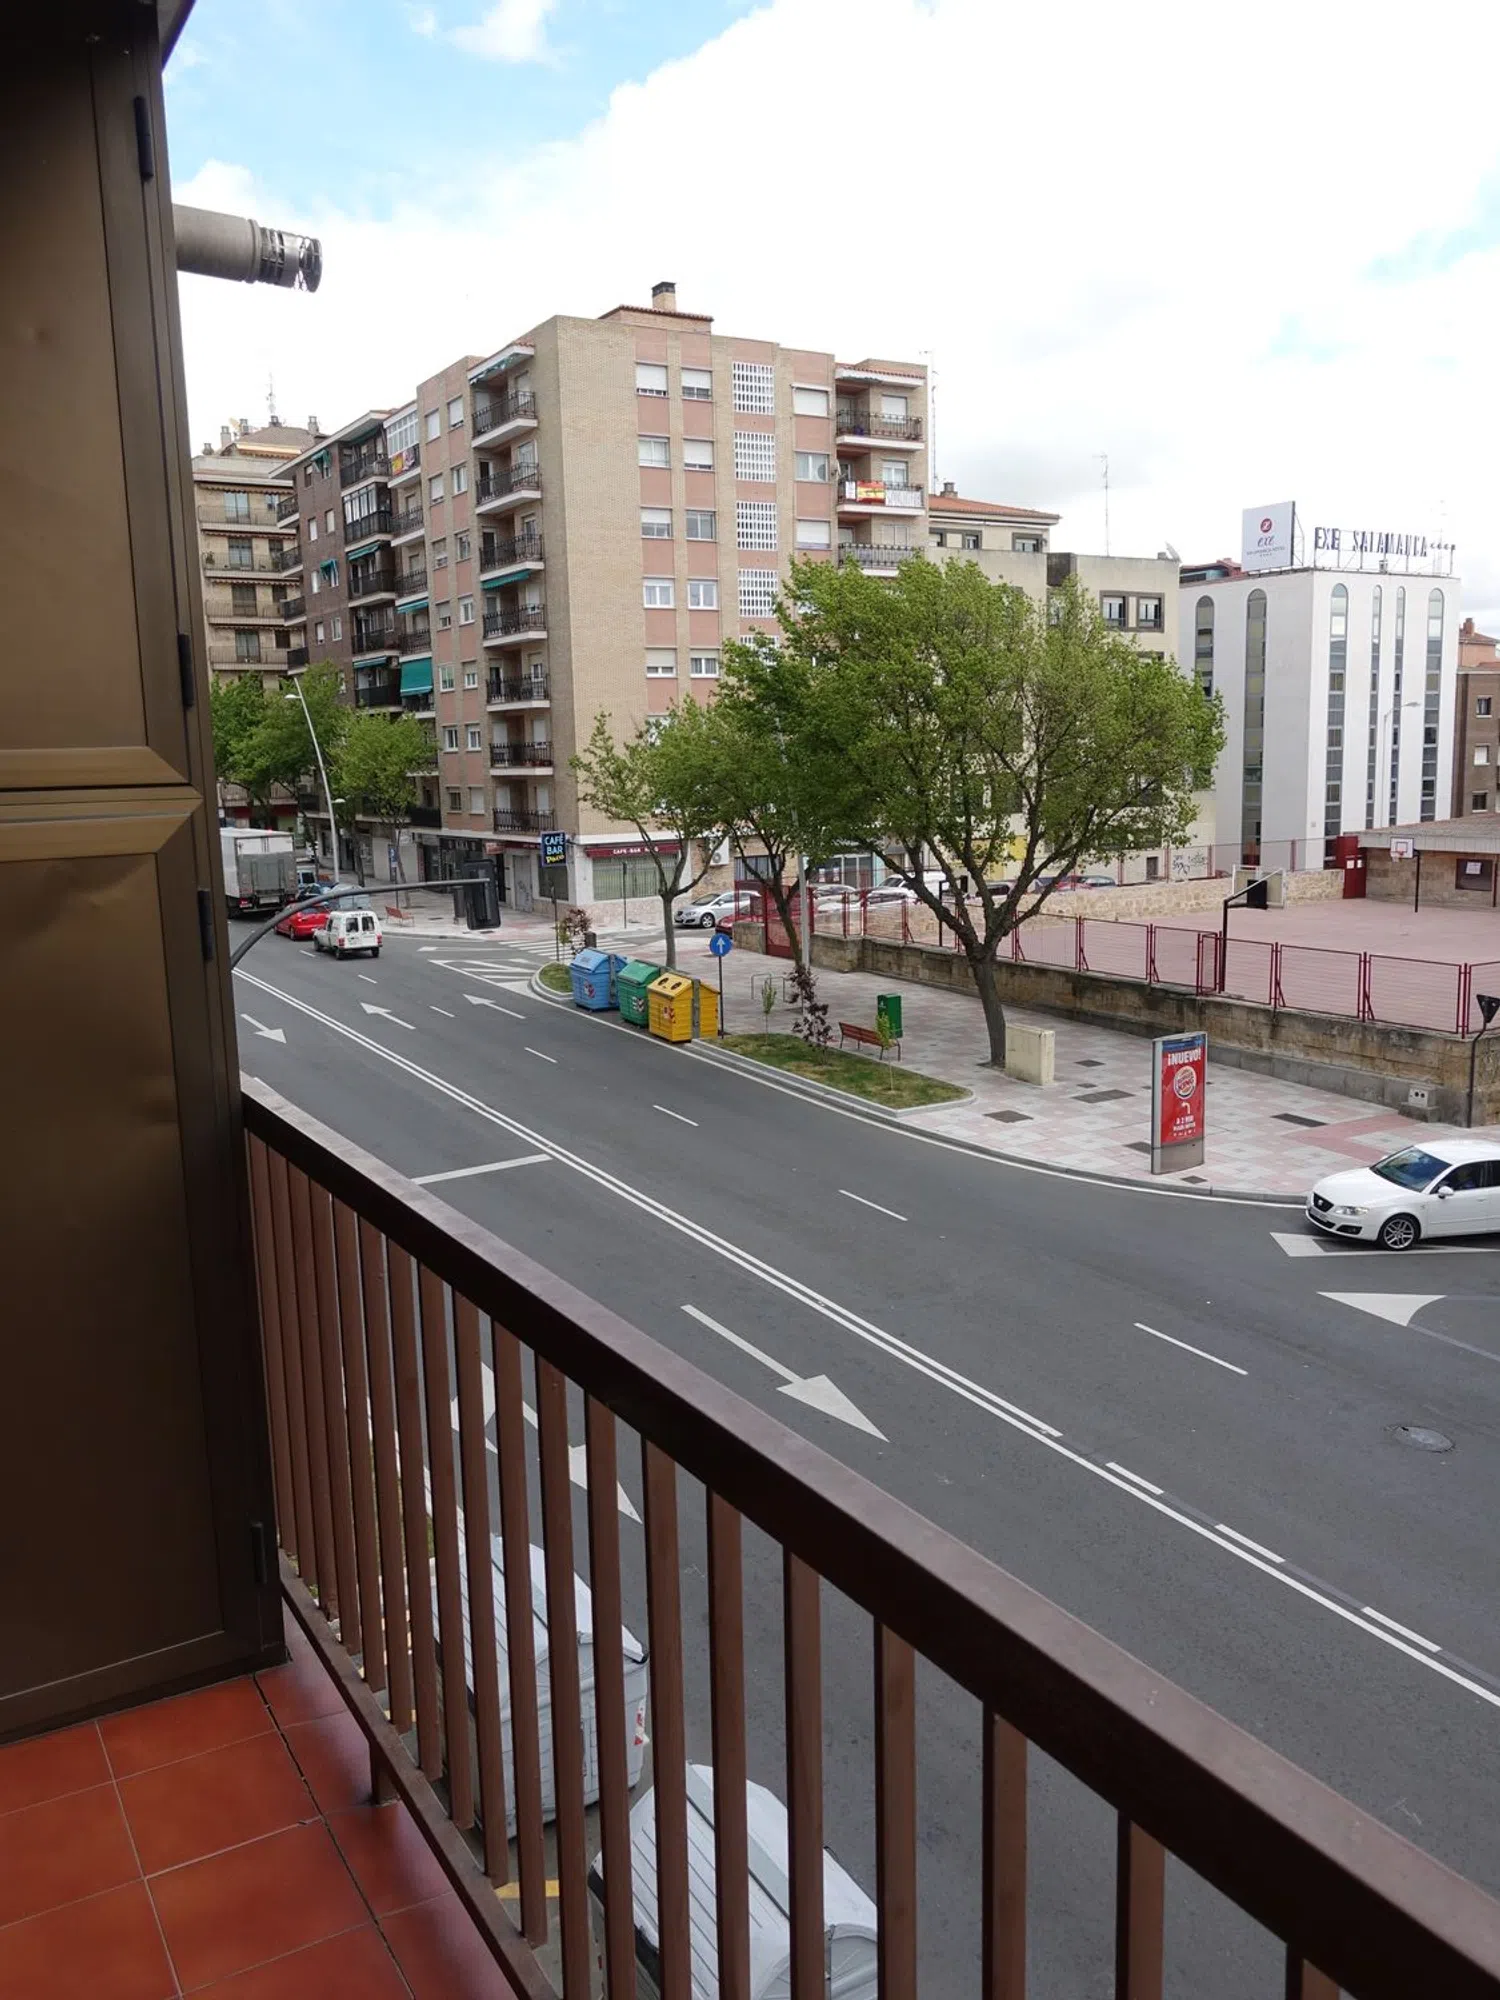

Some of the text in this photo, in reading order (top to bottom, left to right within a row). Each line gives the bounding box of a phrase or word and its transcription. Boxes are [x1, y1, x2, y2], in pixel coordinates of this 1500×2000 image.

[1314, 527, 1340, 550] EXE
[544, 834, 564, 845] CAFÉ
[546, 845, 563, 855] BAR
[1168, 1047, 1201, 1067] ¡NUEVO!
